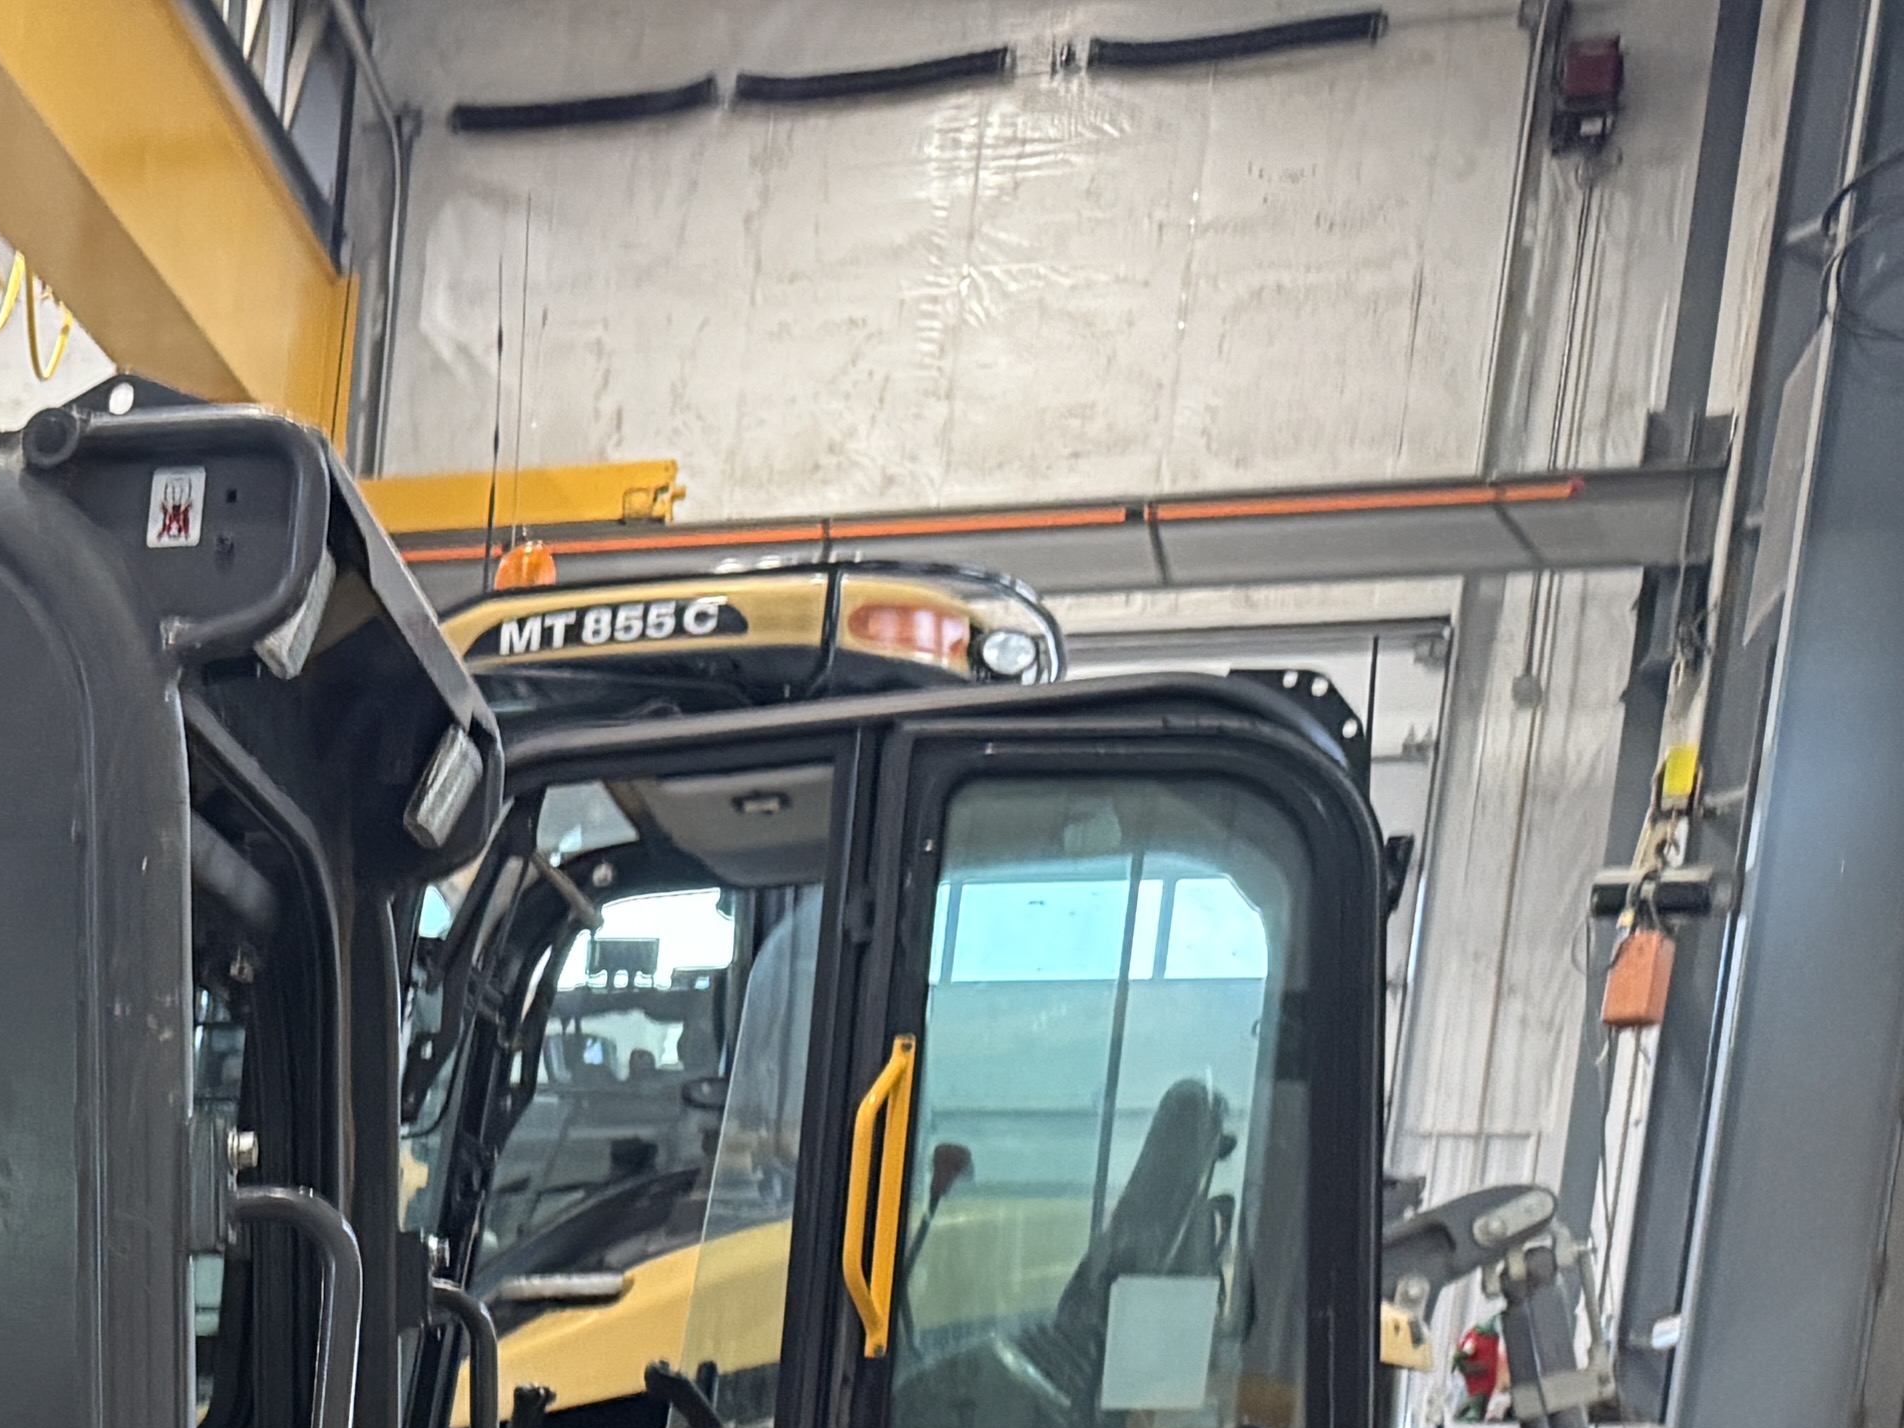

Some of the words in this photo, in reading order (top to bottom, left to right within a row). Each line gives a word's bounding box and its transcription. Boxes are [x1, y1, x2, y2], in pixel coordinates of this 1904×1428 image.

[499, 610, 576, 656] MT
[581, 600, 676, 646] 855
[683, 597, 719, 635] C
